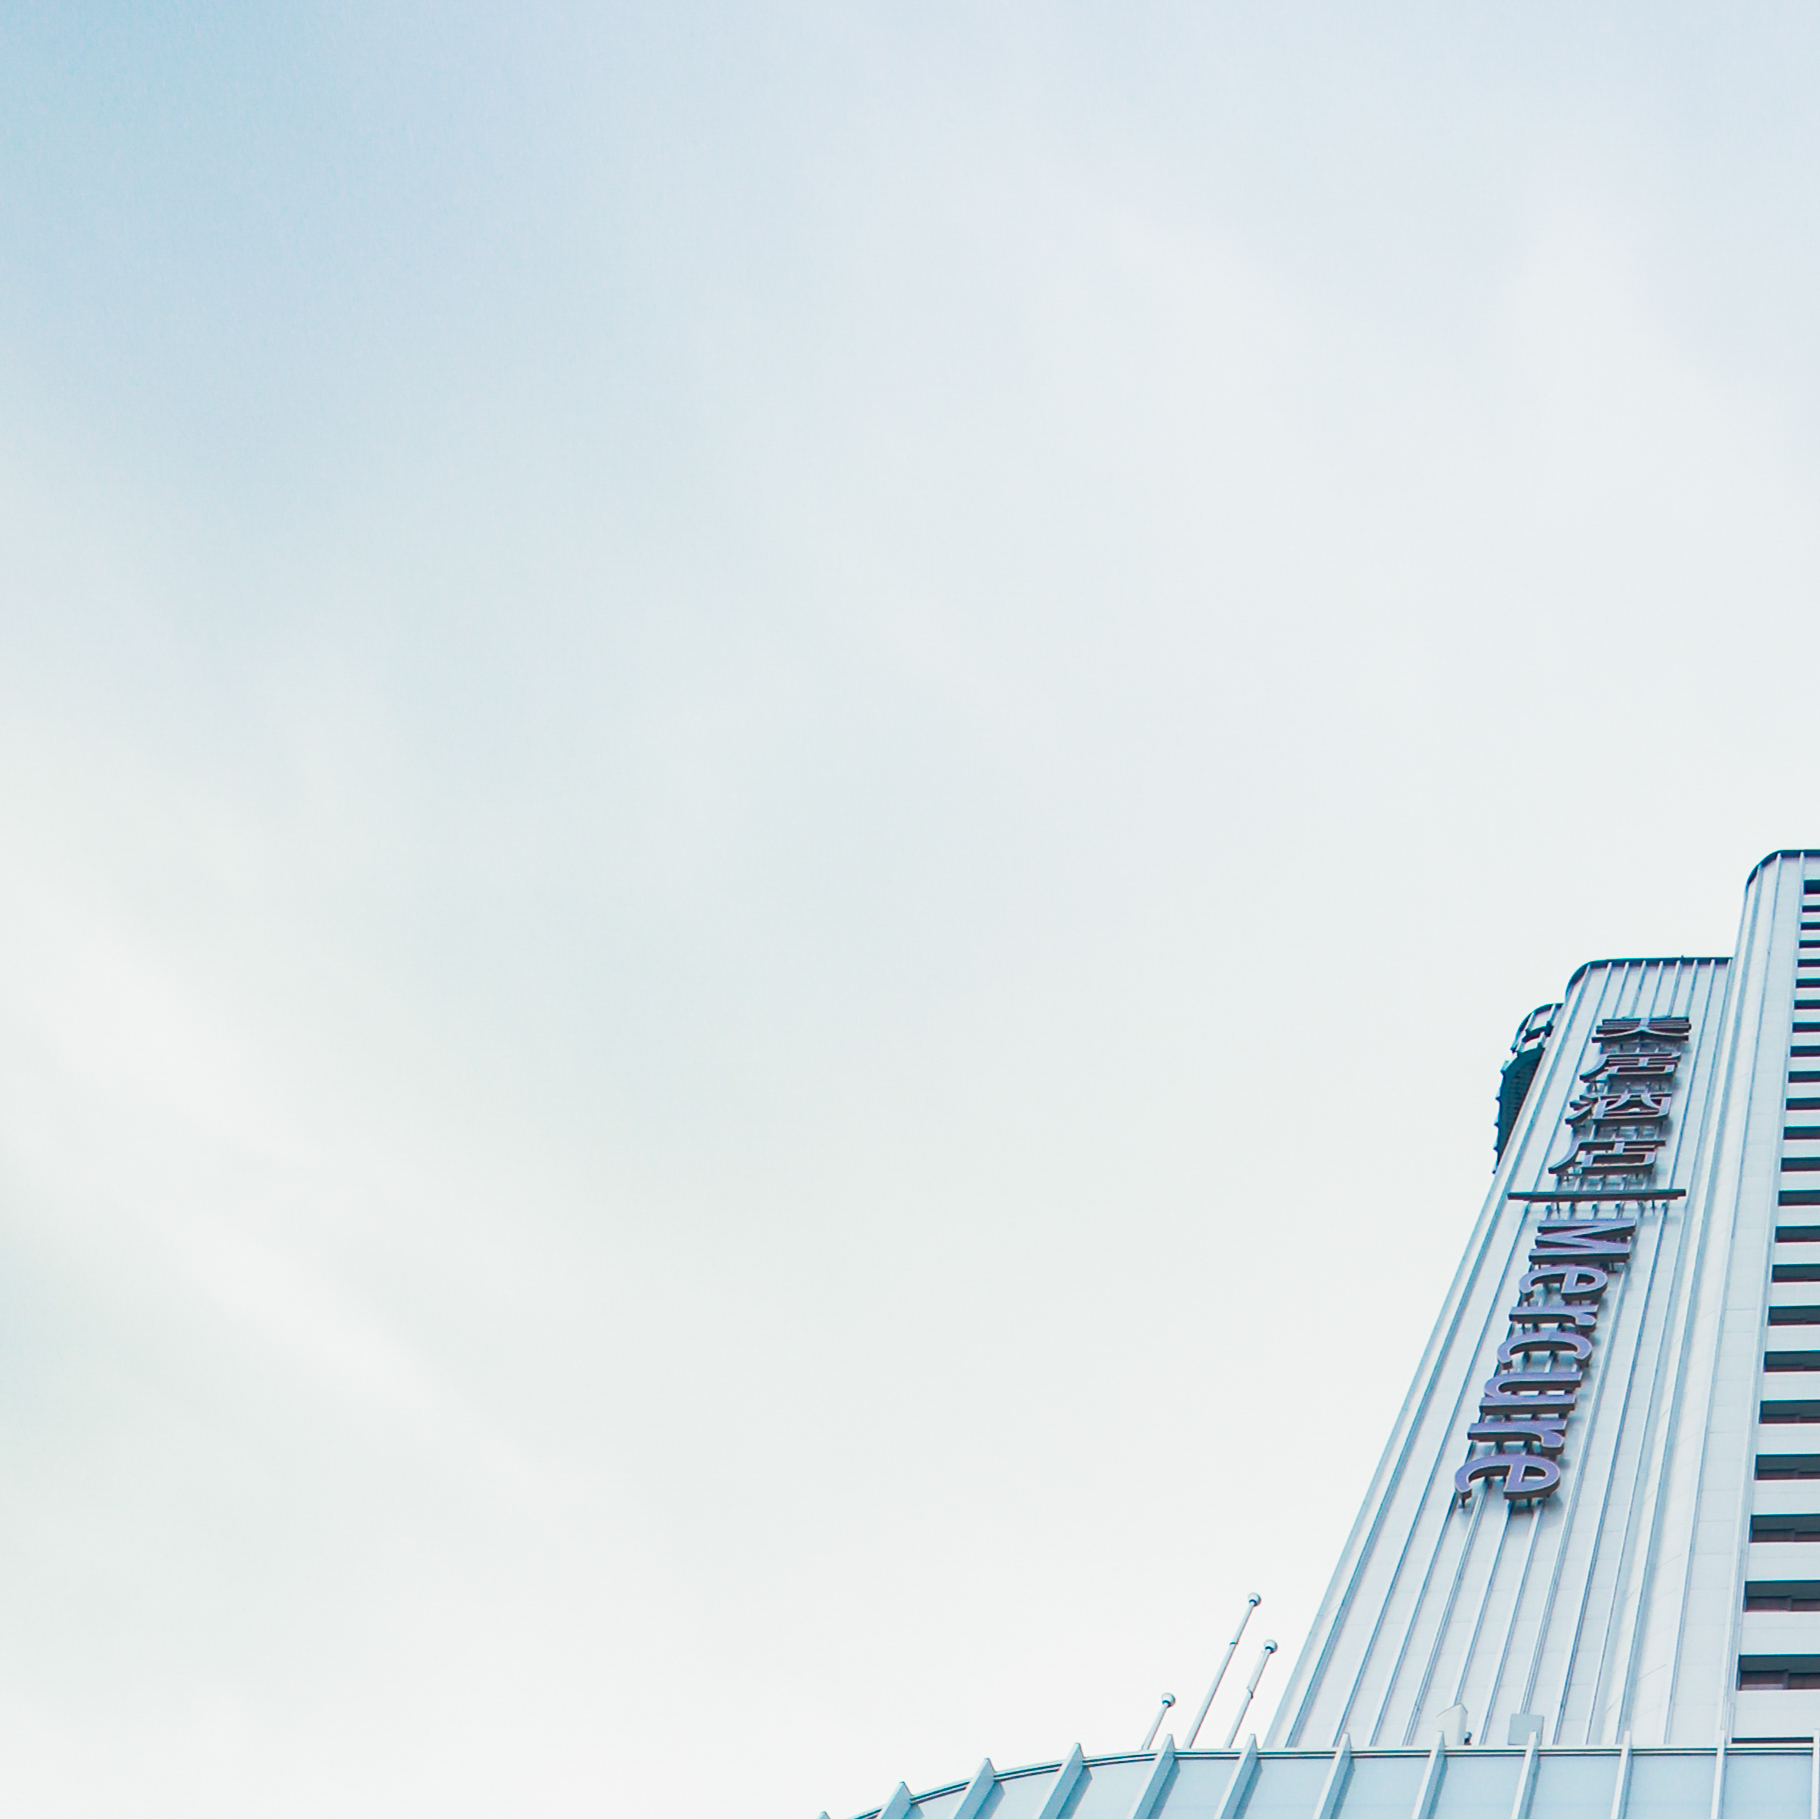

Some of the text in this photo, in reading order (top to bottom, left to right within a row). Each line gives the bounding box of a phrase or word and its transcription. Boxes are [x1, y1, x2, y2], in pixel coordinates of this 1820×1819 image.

[1547, 1016, 1692, 1175] 美居酒店
[1454, 1217, 1637, 1500] Mercure
